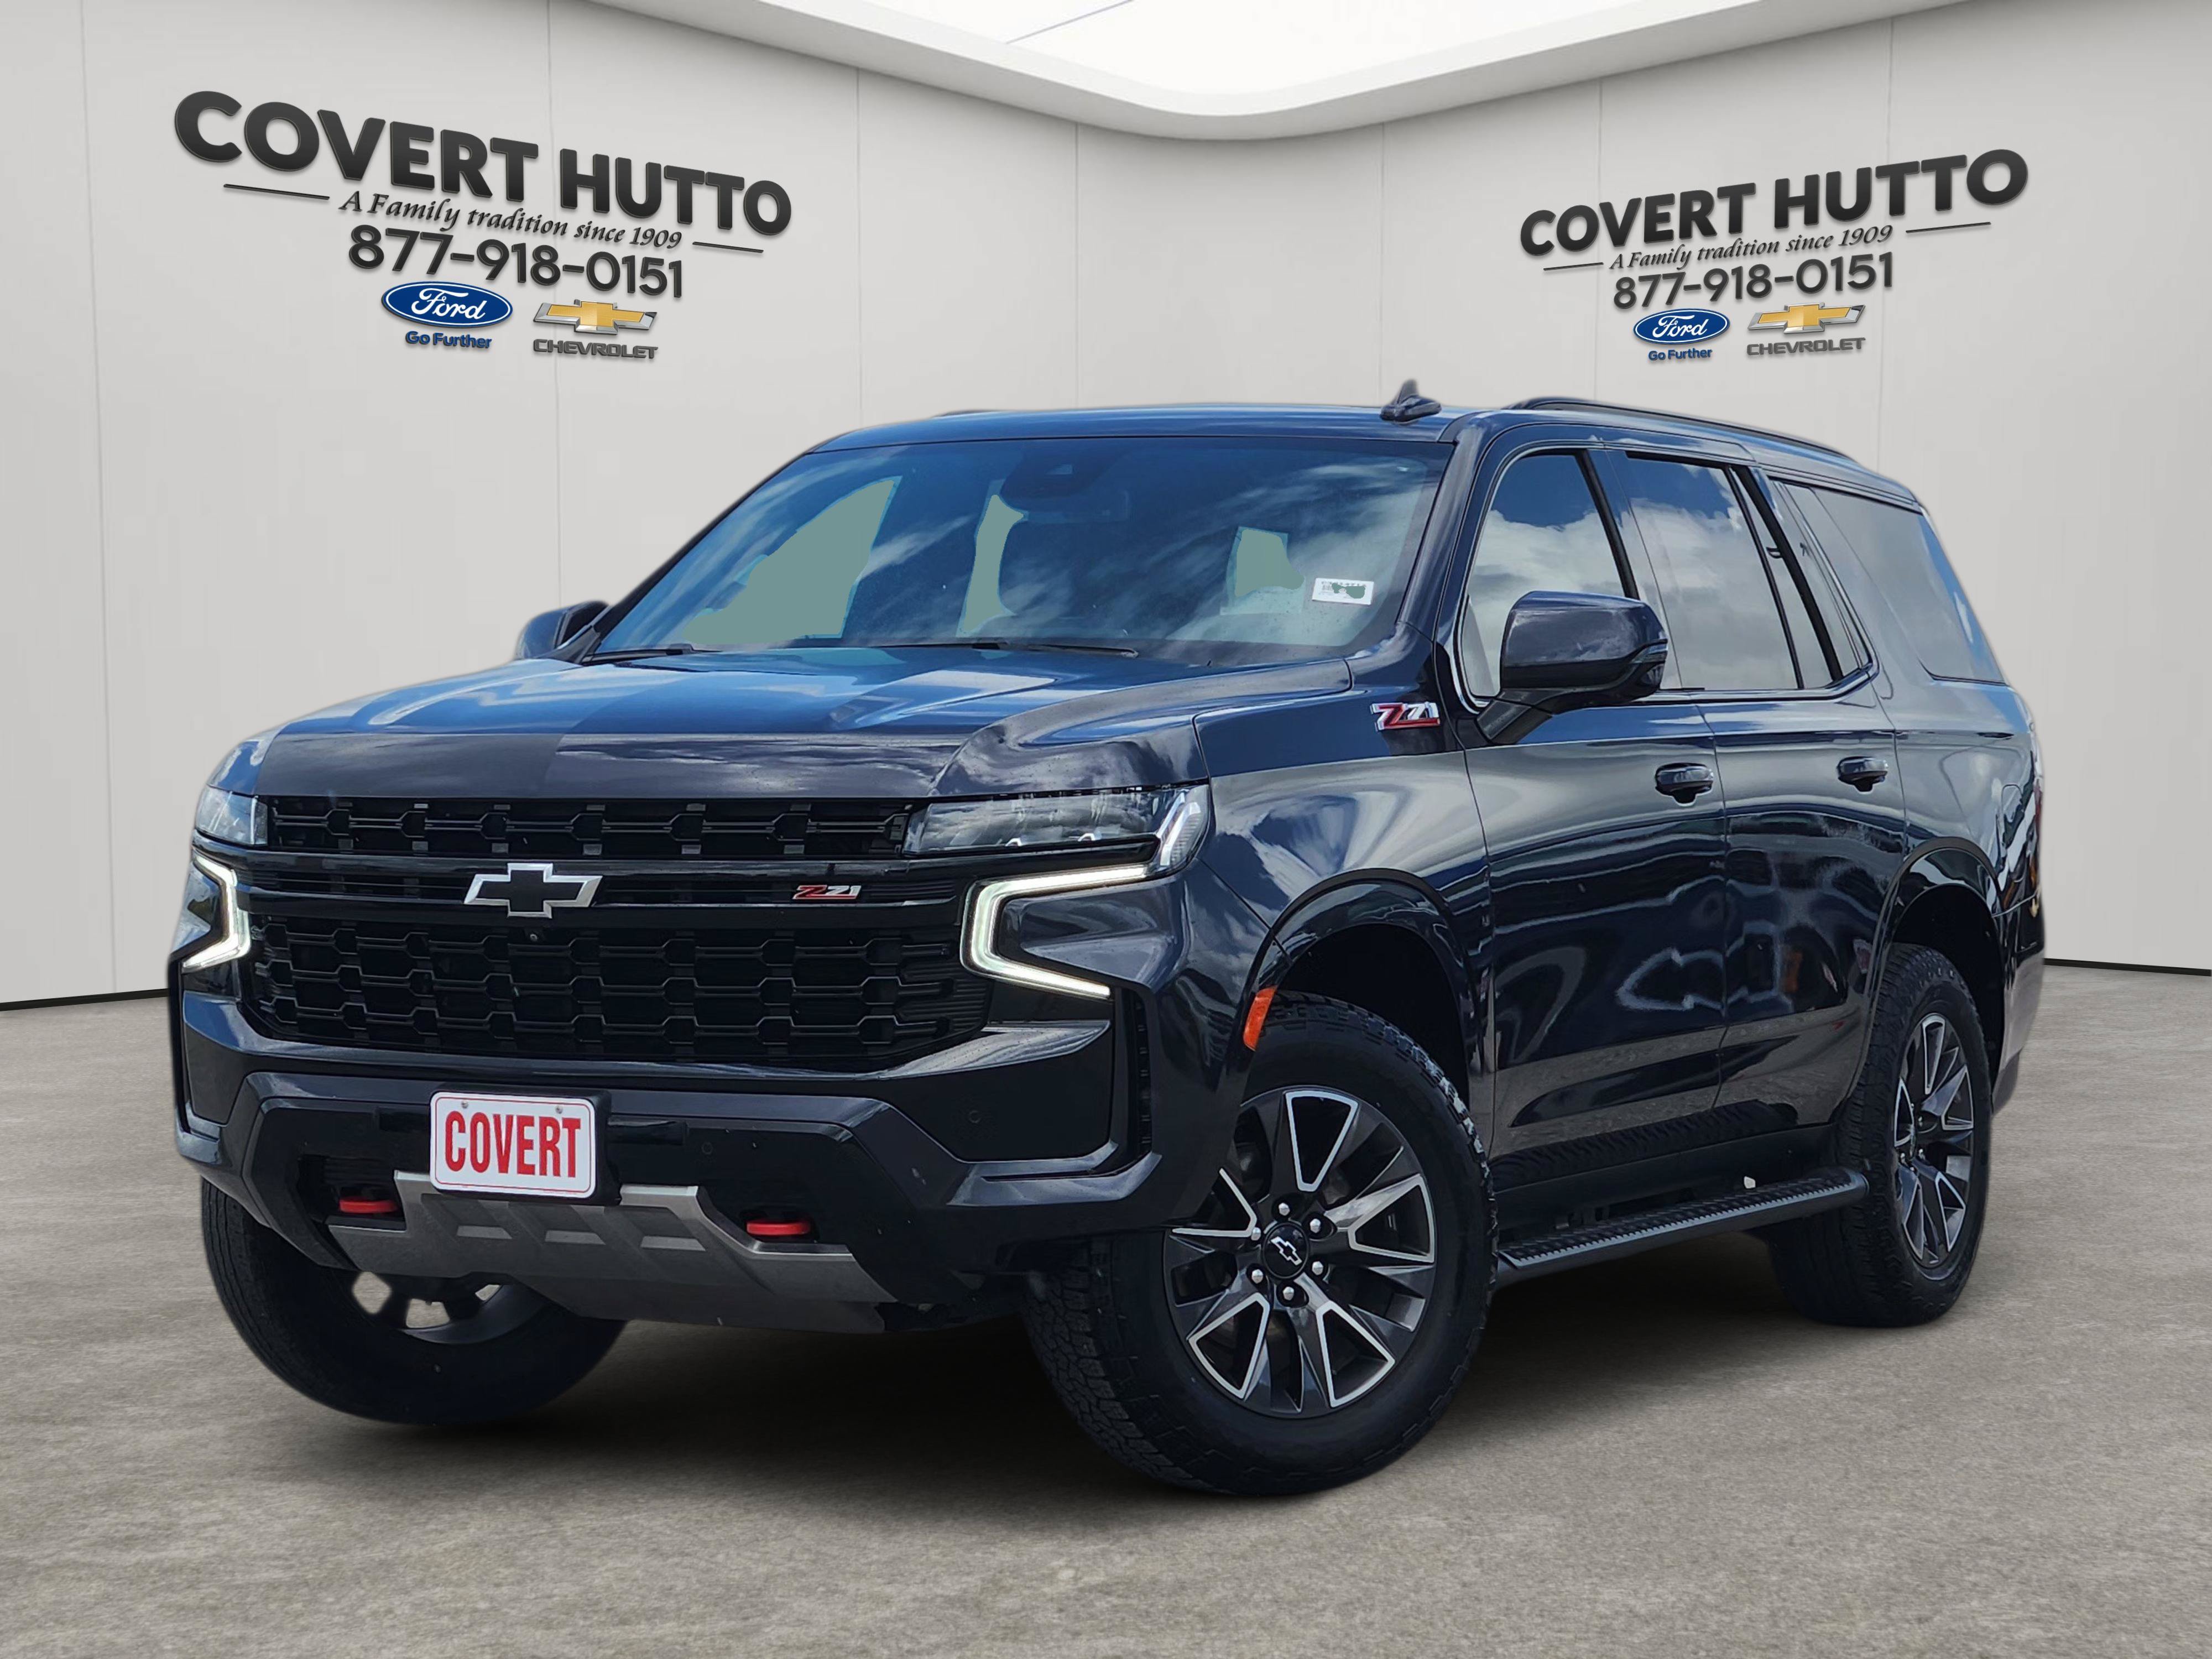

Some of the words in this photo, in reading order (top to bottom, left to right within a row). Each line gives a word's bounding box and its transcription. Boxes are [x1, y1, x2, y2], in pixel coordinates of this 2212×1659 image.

[174, 90, 539, 201] COVERT
[560, 148, 791, 235] HUTTO
[339, 190, 362, 212] A
[369, 194, 461, 232] Family
[467, 207, 567, 236] tradition
[574, 221, 625, 243] since
[630, 227, 682, 249] 1909
[1520, 182, 1756, 256] COVERT
[1774, 149, 2028, 229] HUTTO
[348, 224, 682, 298] 877-918-0151
[1609, 255, 1624, 269] A
[1628, 244, 1692, 270] Family
[1697, 238, 1779, 260] tradition
[1785, 233, 1833, 252] since
[1838, 225, 1893, 247] 1909
[1613, 251, 1892, 309] 877-918-0151
[411, 288, 487, 321] Ford
[1652, 315, 1709, 337] Ford
[405, 331, 430, 345] Go
[434, 332, 492, 348] Further
[534, 338, 658, 358] CHEVROLET
[1648, 349, 1665, 361] Go
[1668, 347, 1713, 359] Further
[1746, 337, 1866, 356] CHEVROLET
[445, 1110, 581, 1178] COVERT
